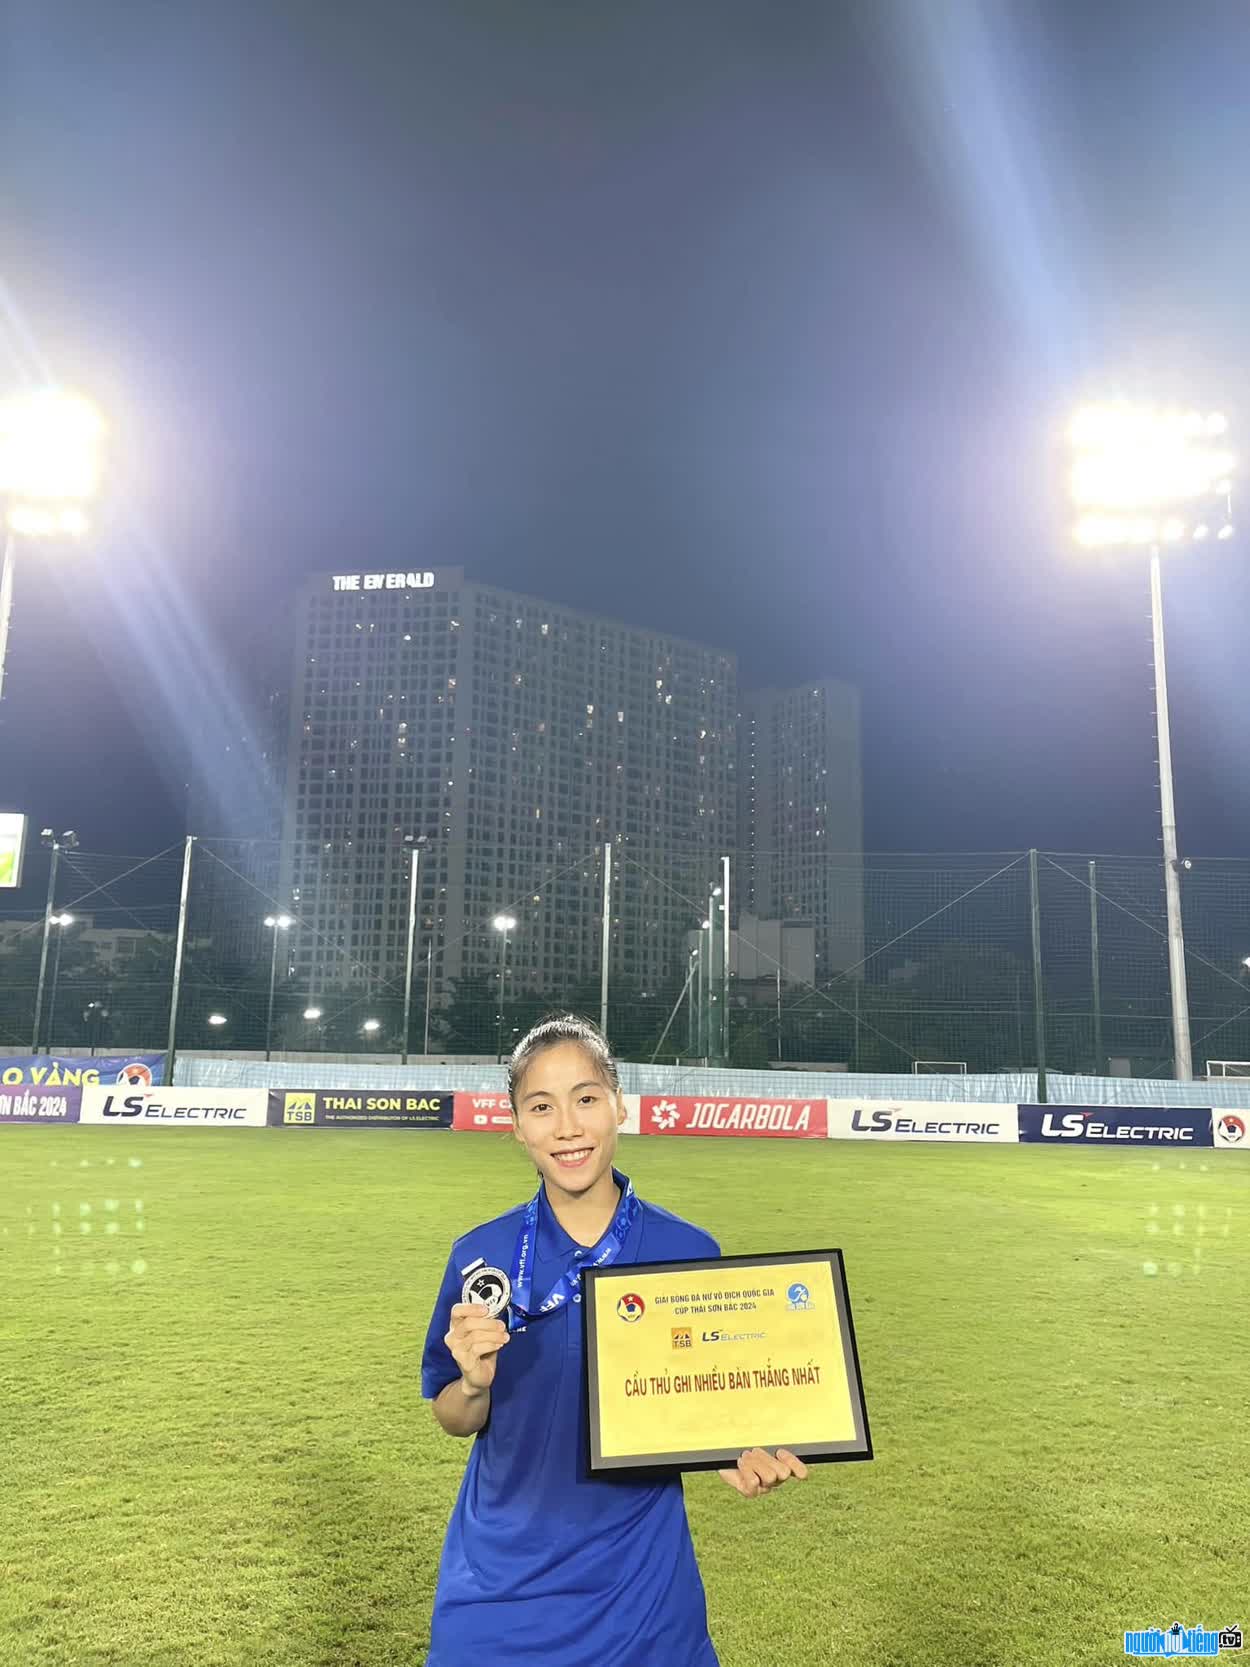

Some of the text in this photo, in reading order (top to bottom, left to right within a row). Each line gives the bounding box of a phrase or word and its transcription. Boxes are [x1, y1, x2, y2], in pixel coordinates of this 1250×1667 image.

[332, 572, 435, 590] THE EMERALD
[30, 1062, 100, 1086] VÀNG
[39, 1096, 67, 1117] 2024
[102, 1096, 144, 1117] LS
[322, 1097, 440, 1111] THAI SON BAC
[472, 1098, 497, 1108] VFF
[287, 1112, 312, 1121] TSB
[686, 1103, 811, 1131] JOGARBOLA
[851, 1110, 893, 1132] LS
[1041, 1114, 1084, 1137] LS
[740, 1301, 757, 1311] 2024
[672, 1340, 692, 1349] TSB
[702, 1331, 720, 1342] LS
[625, 1370, 647, 1397] CẦU
[649, 1368, 671, 1395] THỦ
[673, 1375, 692, 1393] GHI
[694, 1364, 726, 1392] NHIỀU
[791, 1358, 821, 1386] NHẤT
